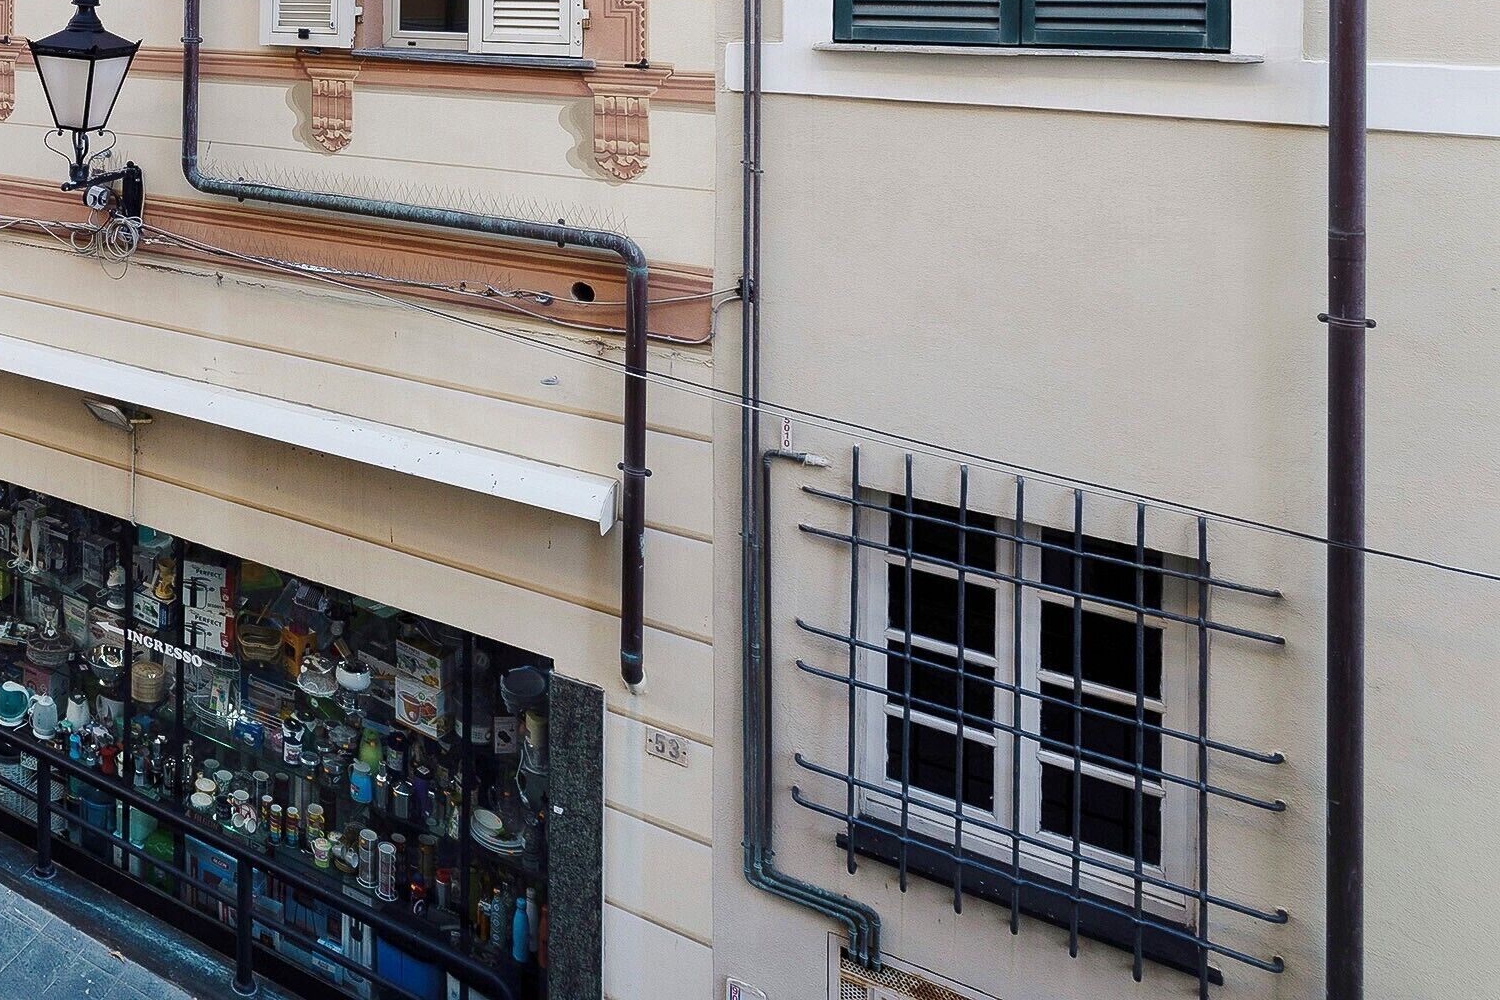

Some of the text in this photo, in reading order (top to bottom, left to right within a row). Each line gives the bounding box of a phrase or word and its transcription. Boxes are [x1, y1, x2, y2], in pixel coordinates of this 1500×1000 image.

[195, 568, 222, 579] PERFECT
[194, 614, 222, 628] PERFECT
[127, 629, 203, 668] INGRESSO
[655, 733, 680, 759] 53
